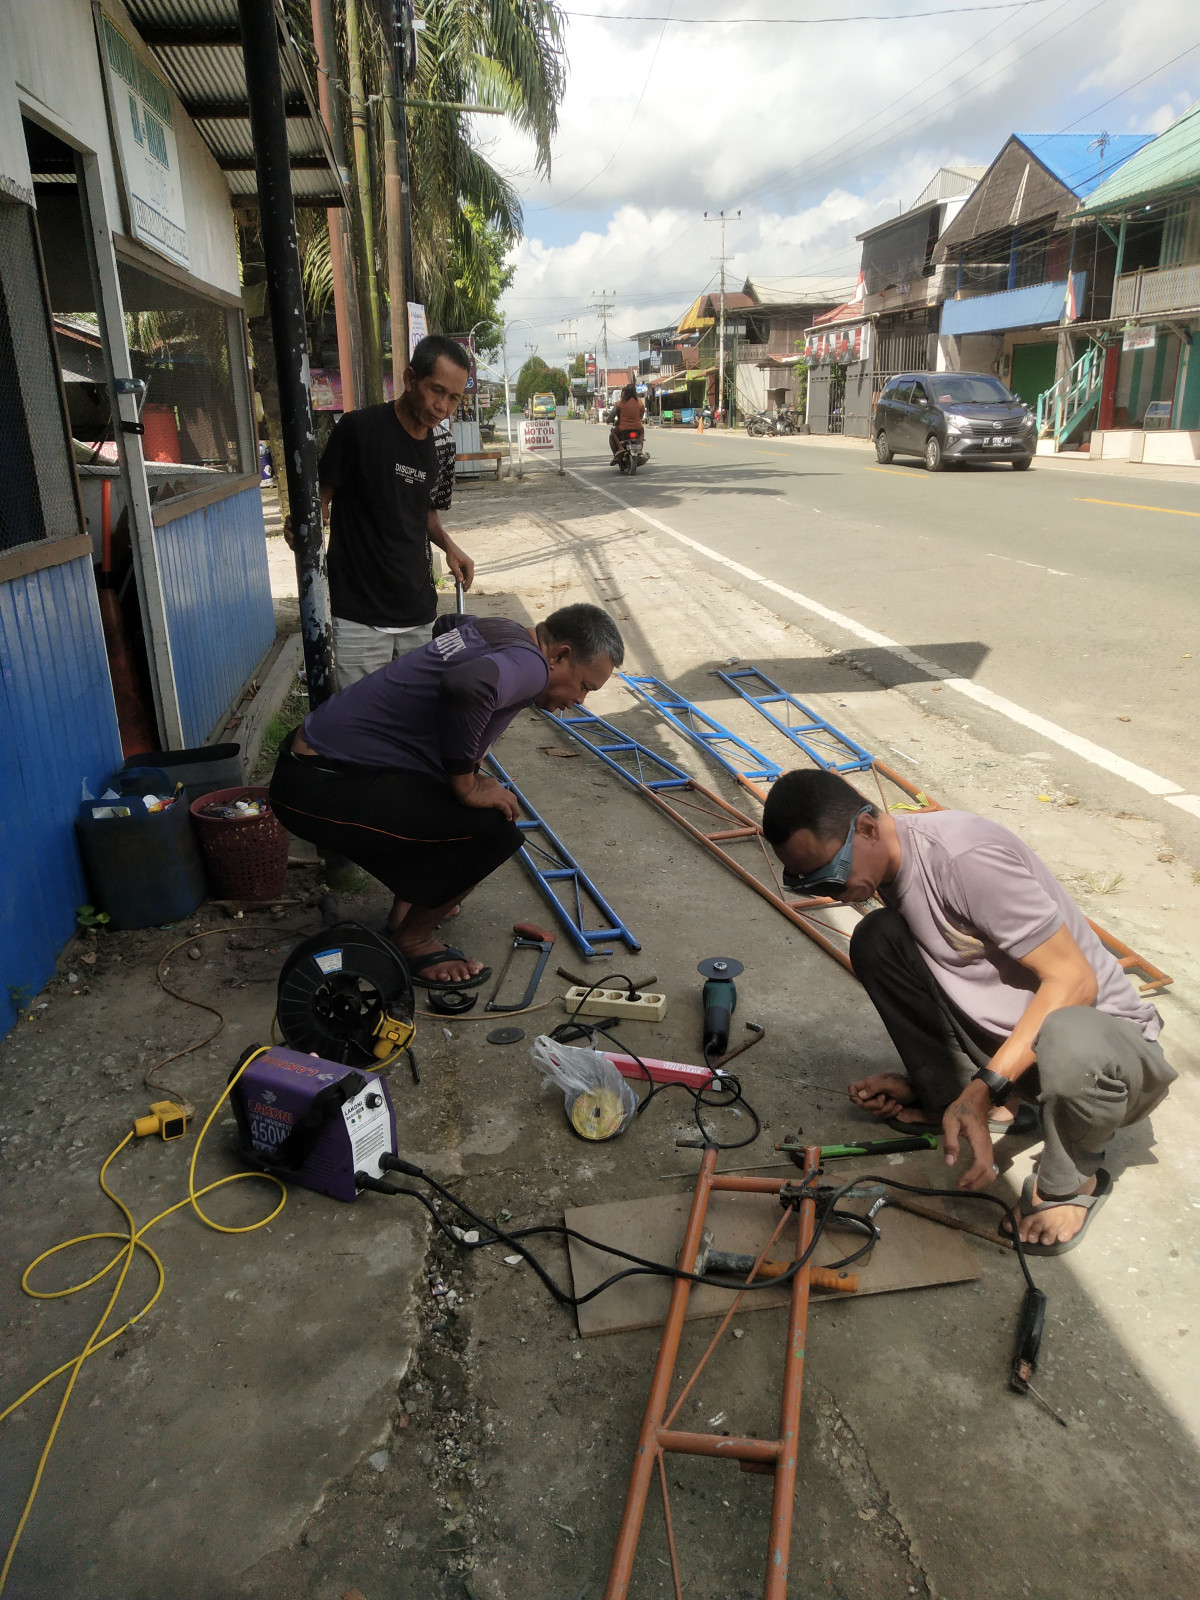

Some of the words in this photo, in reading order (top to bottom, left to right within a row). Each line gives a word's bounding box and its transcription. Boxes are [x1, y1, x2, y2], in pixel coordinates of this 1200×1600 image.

[524, 427, 555, 436] MOTOR
[525, 436, 552, 444] MOBIL
[395, 463, 427, 480] DISCIPLINE
[258, 1055, 319, 1077] LAKONI
[247, 1099, 294, 1125] LAKONI
[344, 1101, 363, 1116] LAKONI
